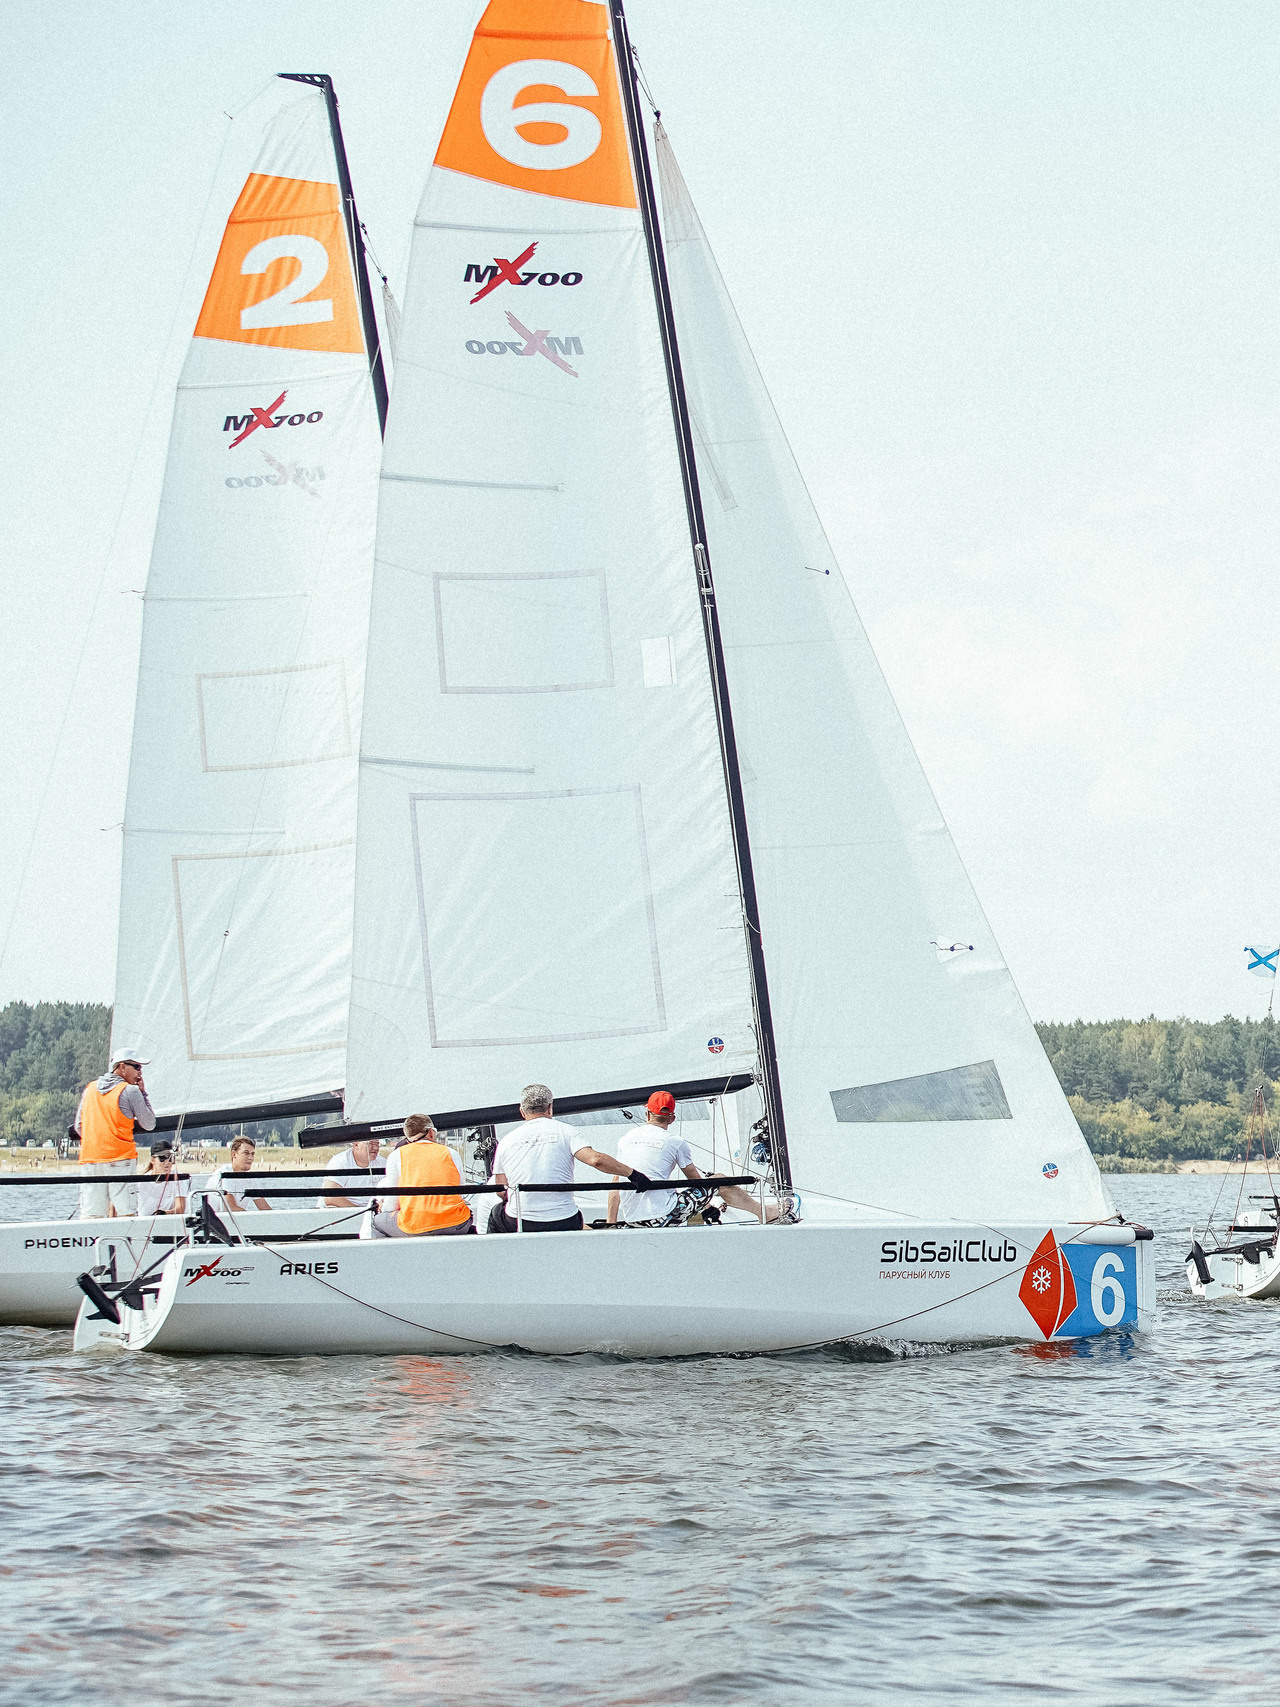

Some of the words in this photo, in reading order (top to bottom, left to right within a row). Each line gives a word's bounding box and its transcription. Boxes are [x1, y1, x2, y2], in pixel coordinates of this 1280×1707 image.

[480, 59, 602, 170] 6
[240, 234, 334, 330] 2
[463, 241, 584, 305] MX700
[222, 389, 324, 450] MX700
[25, 1236, 99, 1249] PHOENIX
[880, 1240, 1017, 1263] SibSailClub
[183, 1255, 242, 1287] MX700
[280, 1262, 338, 1275] ARIES
[879, 1269, 927, 1279] ПАРУСНЫЙ
[928, 1270, 951, 1279] КЛУБ
[1090, 1252, 1126, 1327] 6
